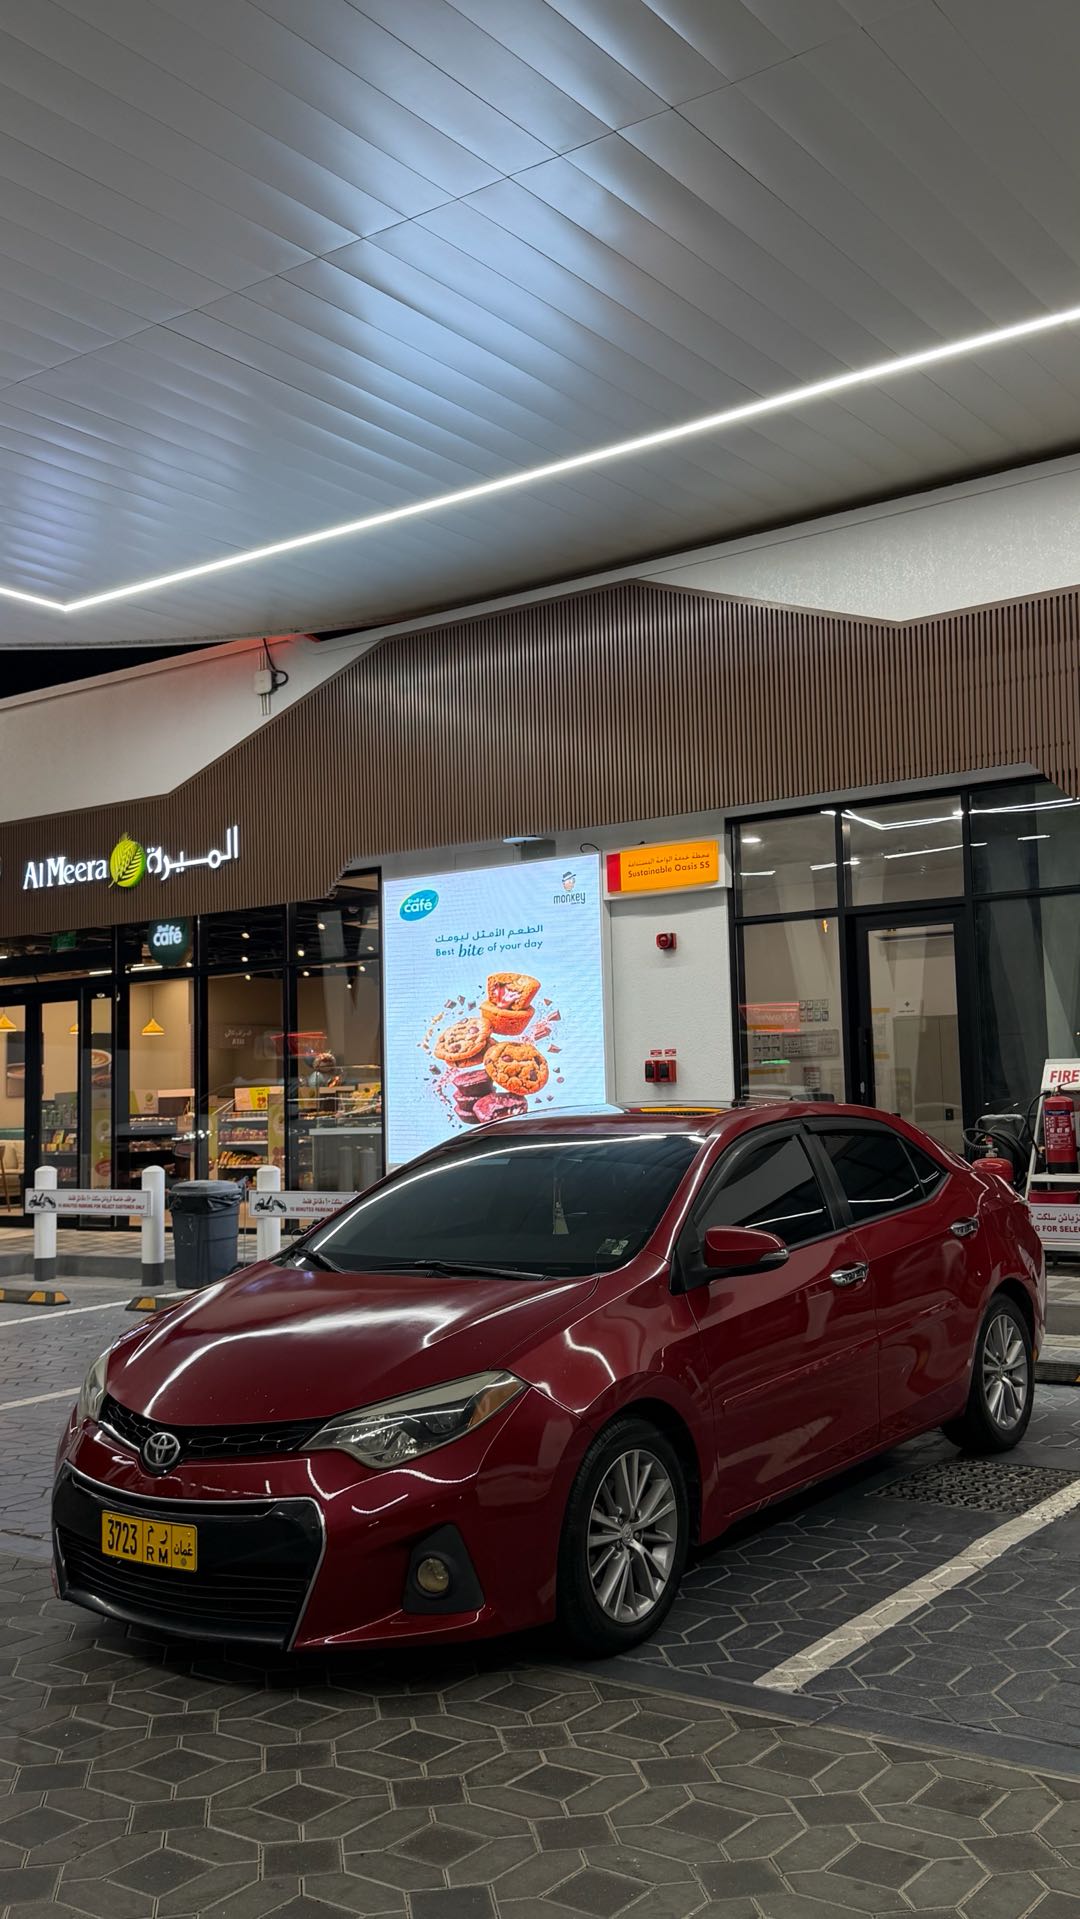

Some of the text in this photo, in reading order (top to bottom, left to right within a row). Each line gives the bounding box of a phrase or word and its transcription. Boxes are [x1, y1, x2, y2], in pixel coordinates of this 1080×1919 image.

[147, 825, 238, 881] الميرة
[628, 861, 710, 878] Sustainable Oasis SS
[404, 898, 432, 913] café
[553, 892, 586, 904] monkey
[153, 925, 182, 947] café
[435, 925, 543, 943] الطعم الأمثل ليومك
[435, 939, 544, 958] Best bite of your day
[1050, 1069, 1080, 1083] FIRE
[107, 1518, 138, 1555] 3723
